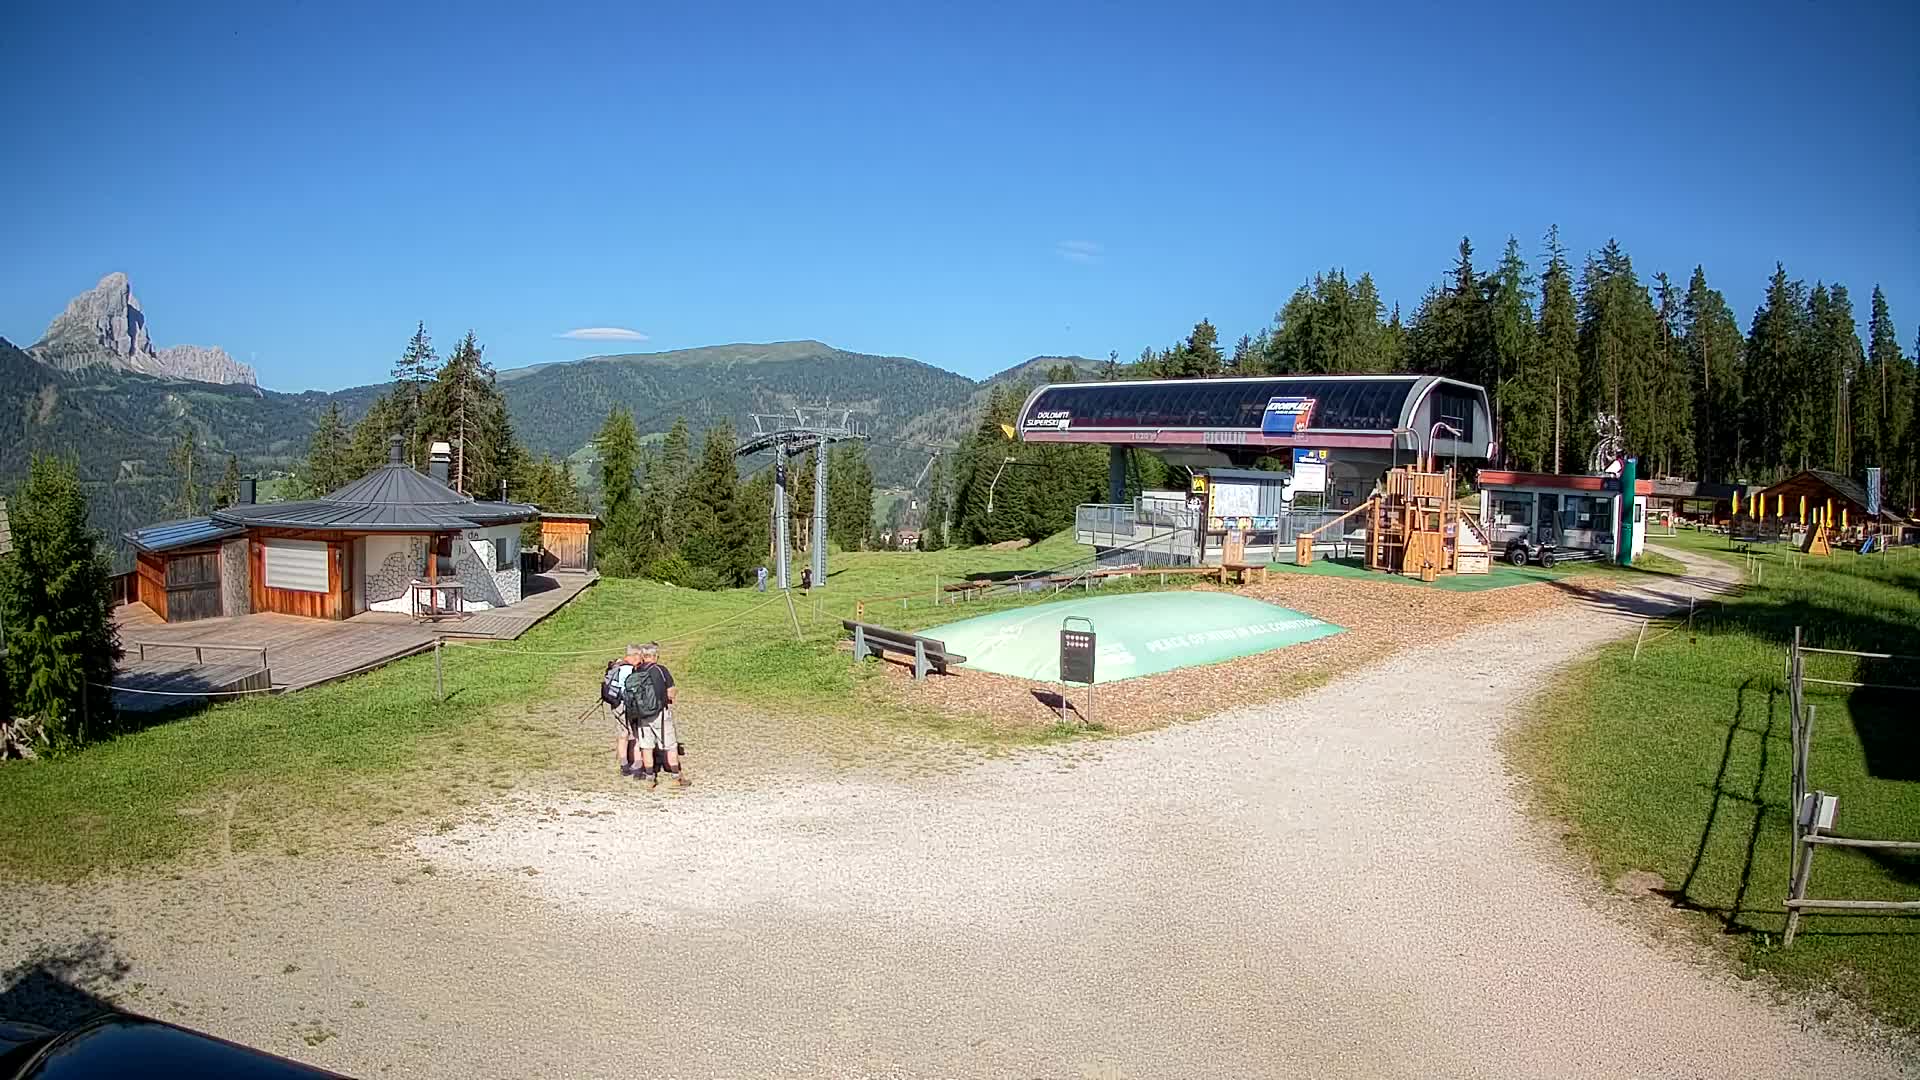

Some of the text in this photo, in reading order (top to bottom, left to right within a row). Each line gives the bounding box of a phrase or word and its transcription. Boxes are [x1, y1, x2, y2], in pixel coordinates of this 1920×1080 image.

[1037, 411, 1069, 419] DOLOMITI
[1145, 637, 1189, 653] PEACE
[1188, 632, 1206, 646] OF
